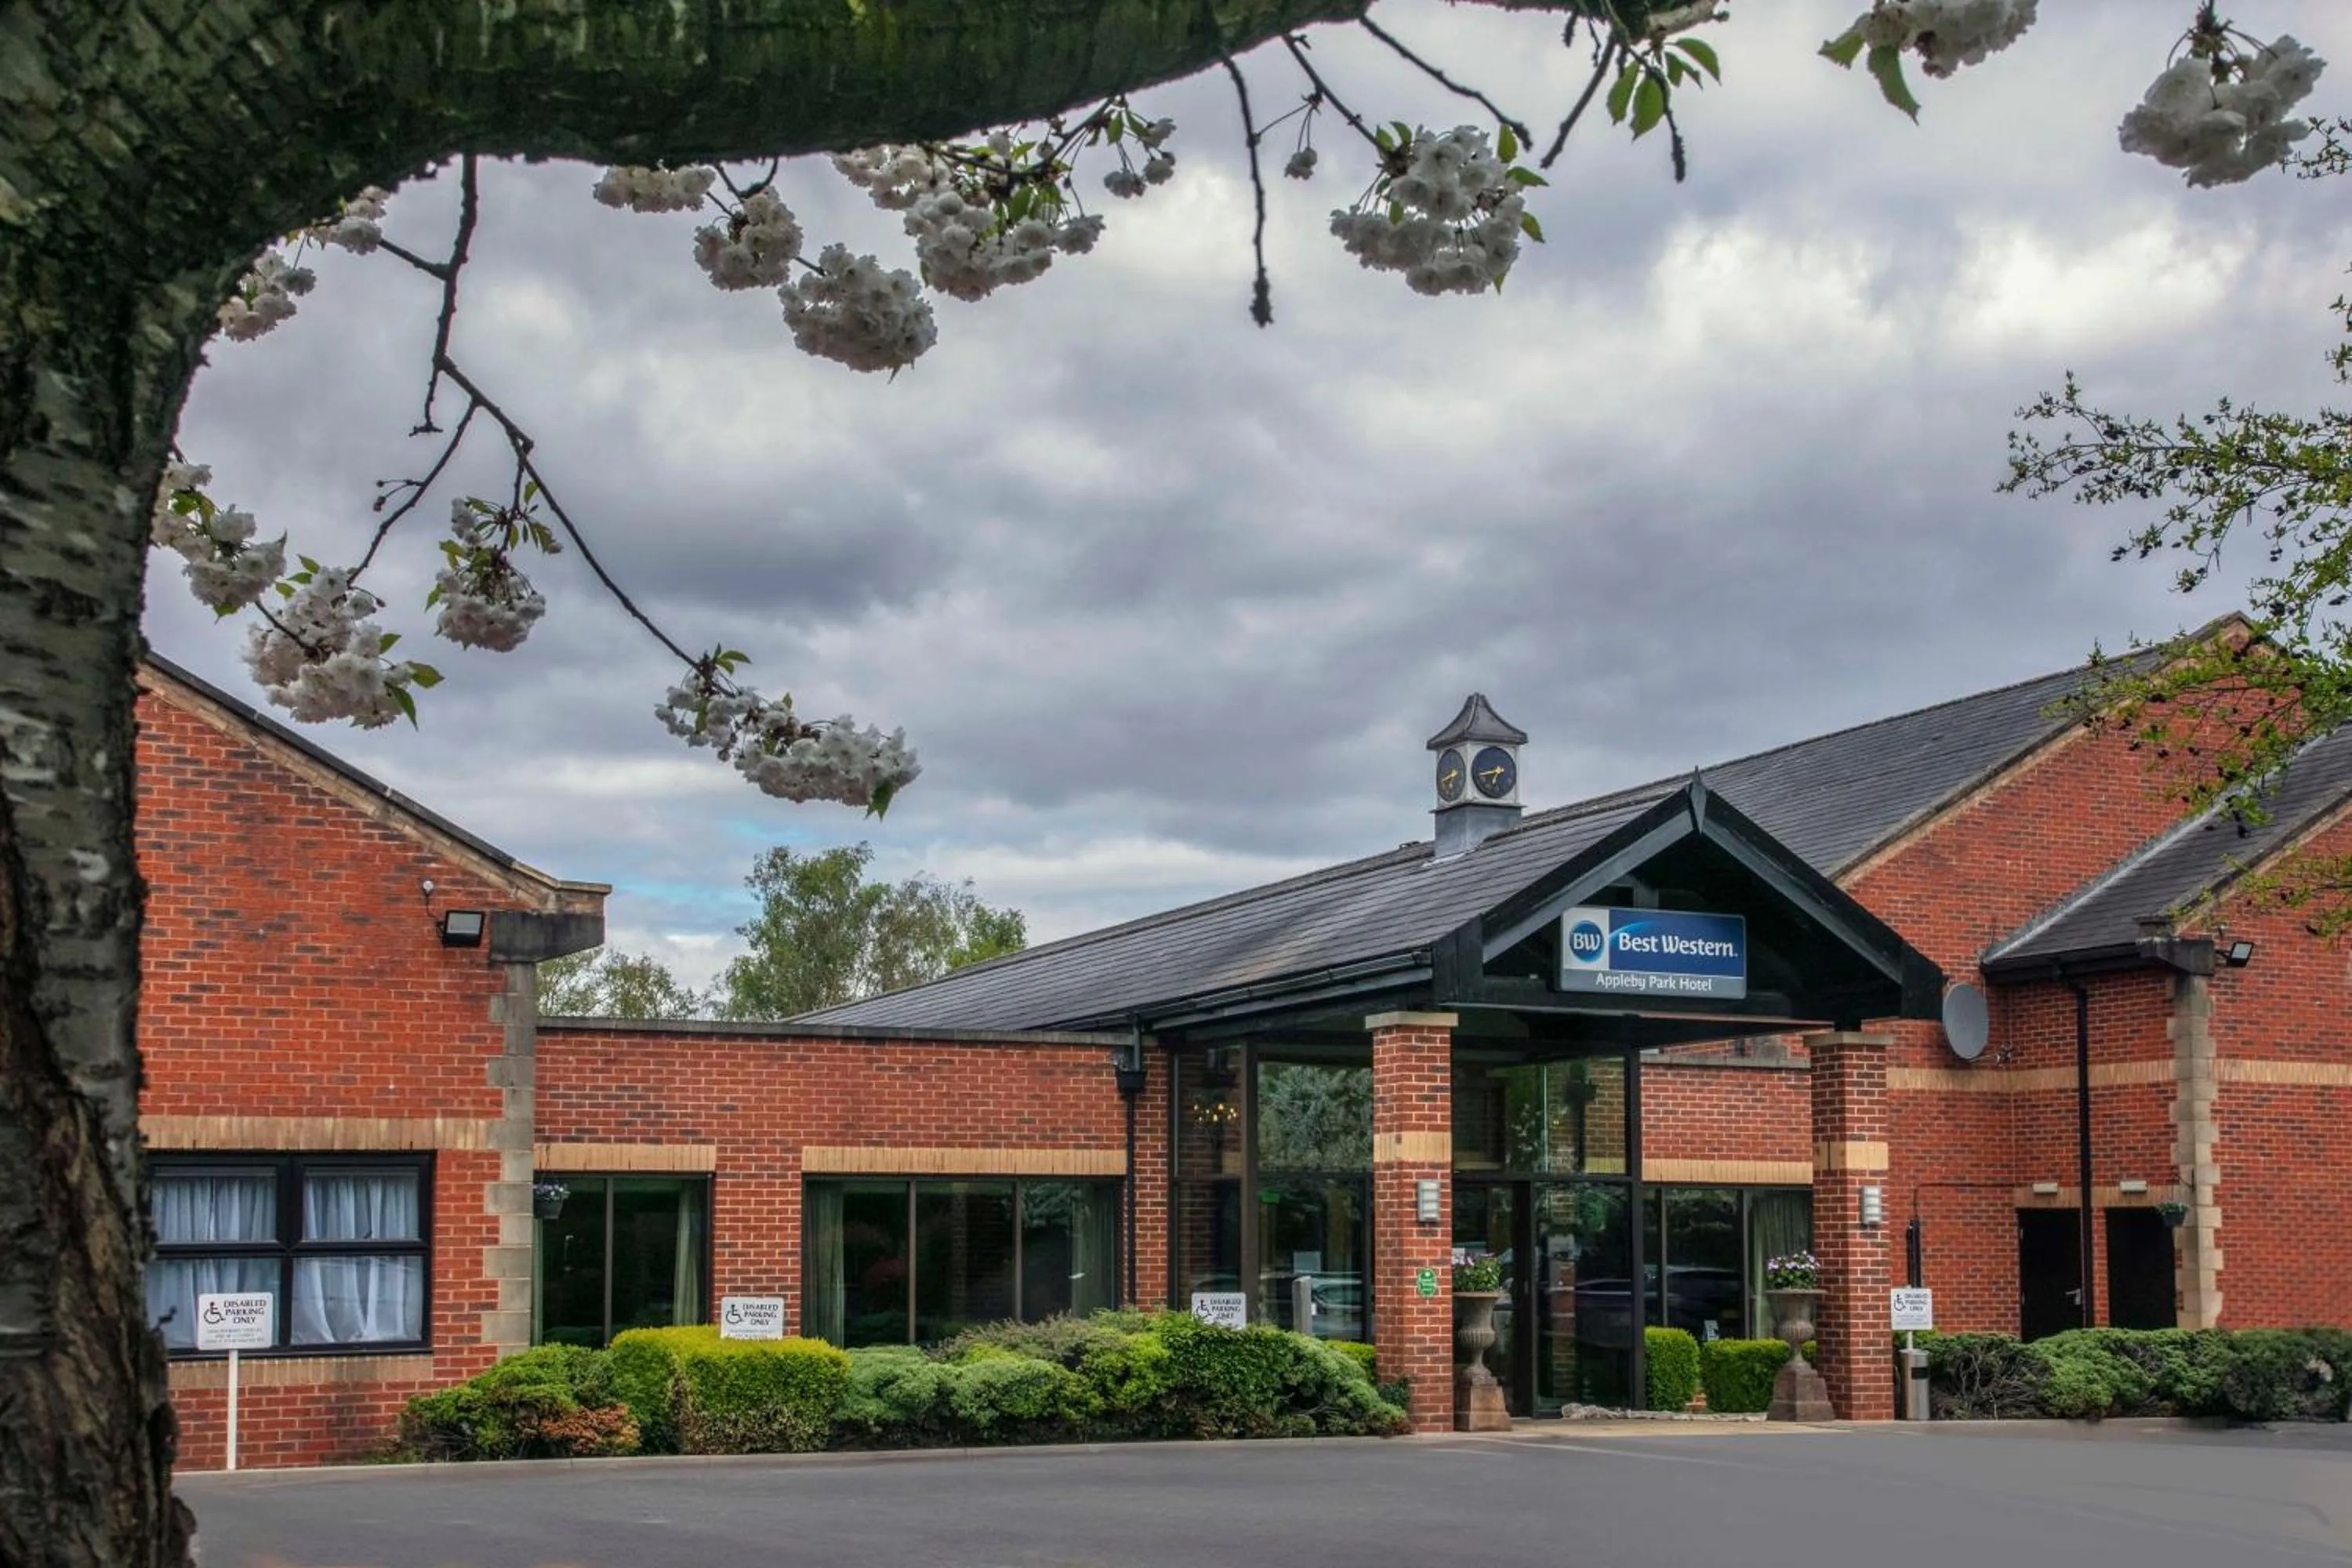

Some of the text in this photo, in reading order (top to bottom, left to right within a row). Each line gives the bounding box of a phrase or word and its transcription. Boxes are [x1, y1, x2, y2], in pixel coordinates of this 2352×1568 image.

[1573, 932, 1600, 951] BW
[1619, 932, 1658, 953] Best
[1595, 973, 1712, 992] Appleby Park Hotel
[223, 1298, 267, 1308] DISABLED
[225, 1307, 264, 1316] PARKING
